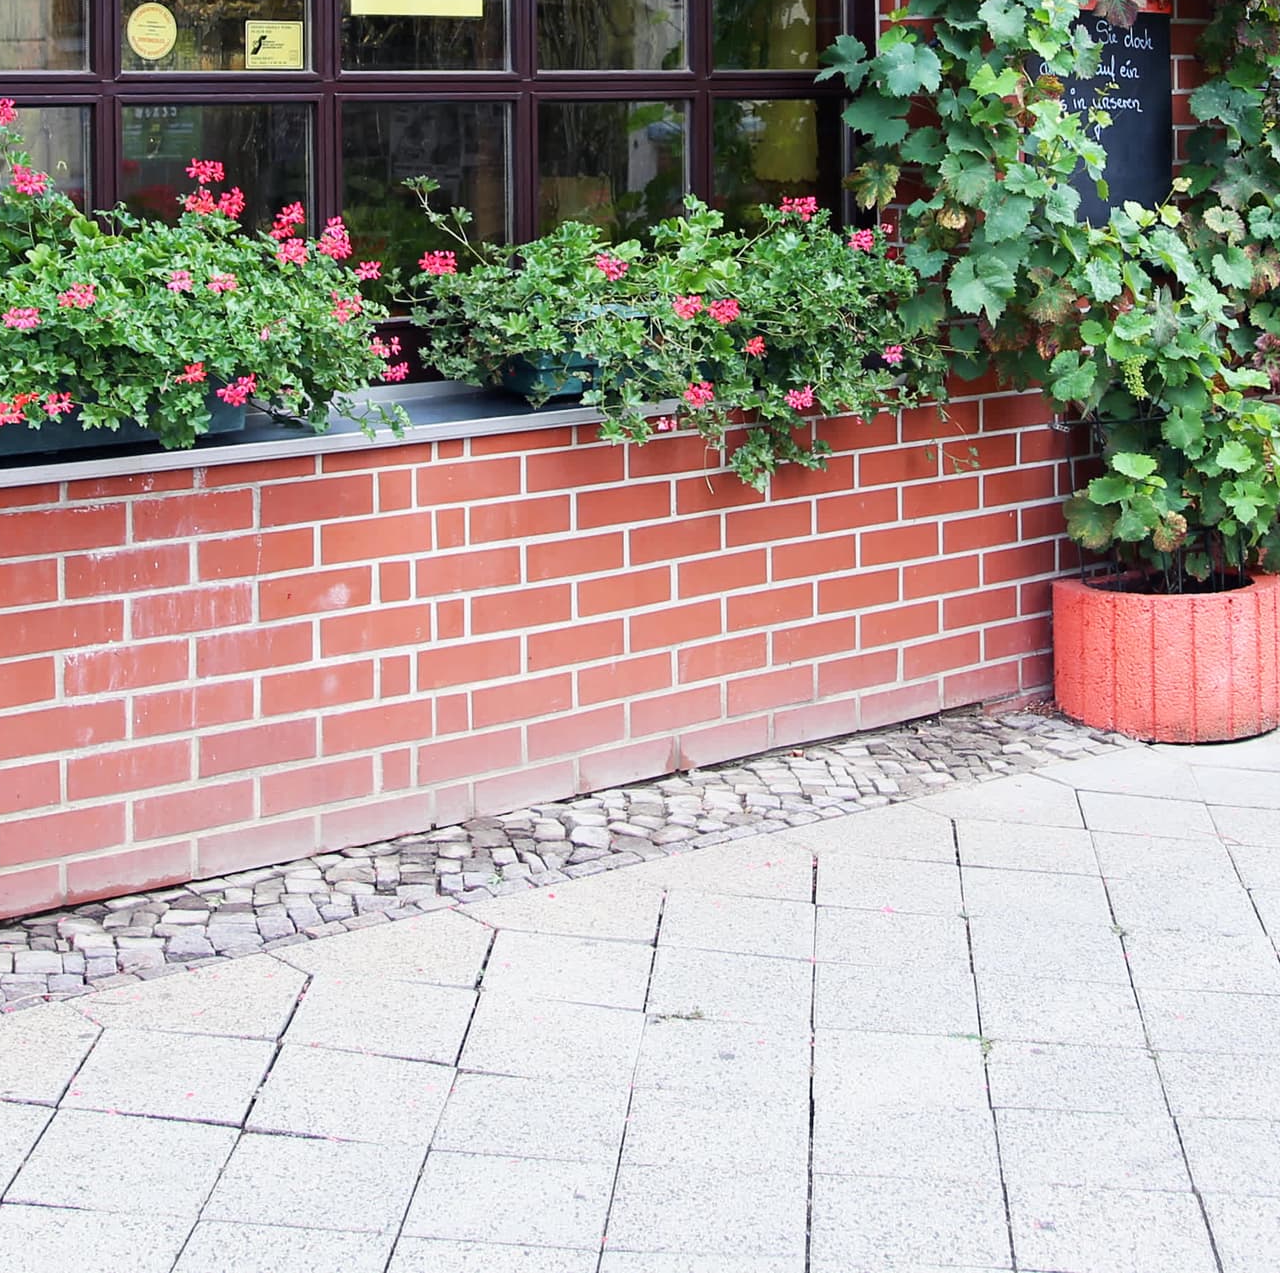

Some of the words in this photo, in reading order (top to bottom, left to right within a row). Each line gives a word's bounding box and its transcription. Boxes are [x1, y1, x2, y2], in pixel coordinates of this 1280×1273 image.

[1096, 20, 1118, 44] Sie
[1120, 60, 1140, 78] ein
[1092, 97, 1143, 113] unseren
